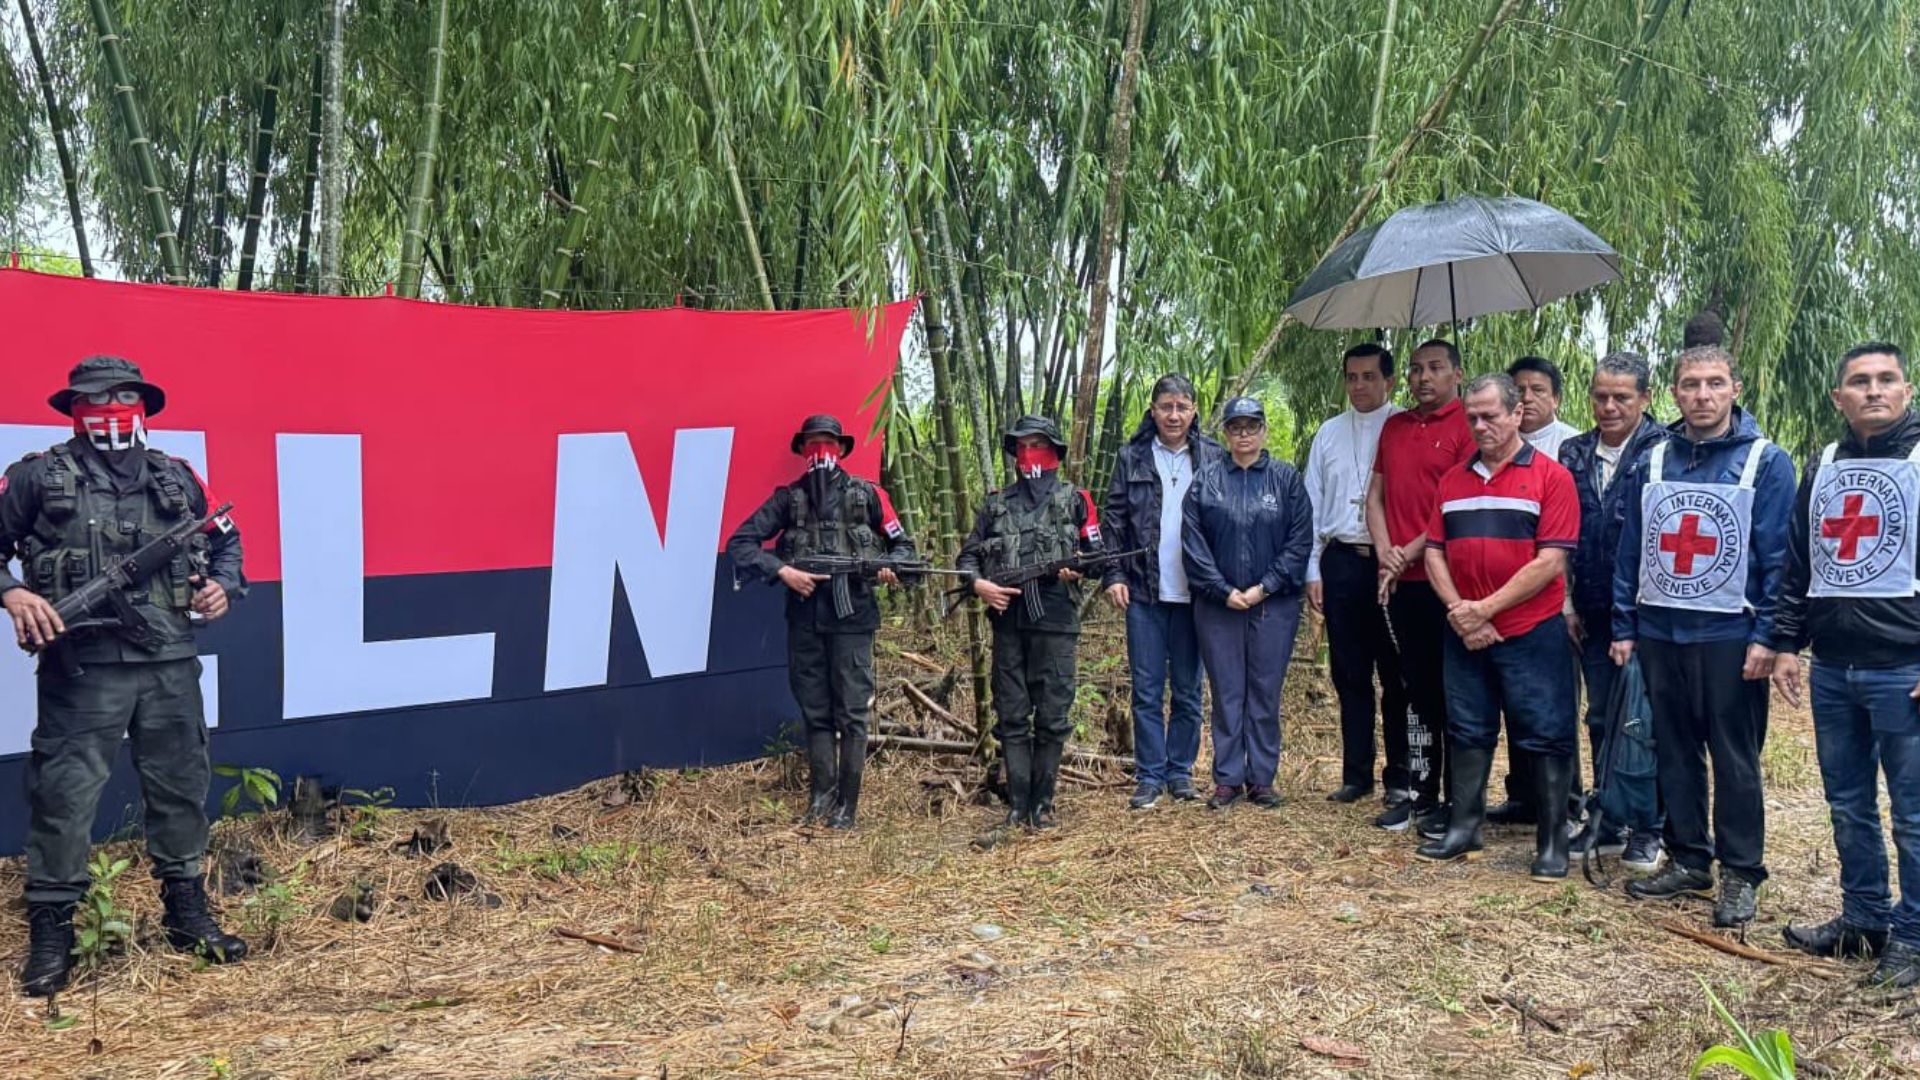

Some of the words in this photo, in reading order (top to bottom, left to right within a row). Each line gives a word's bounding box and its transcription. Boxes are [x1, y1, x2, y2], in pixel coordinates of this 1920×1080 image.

[82, 414, 149, 451] ELN
[1647, 508, 1666, 568] COMITE
[1671, 494, 1738, 574] INTERNATIONAL
[1656, 572, 1712, 595] GENEVE
